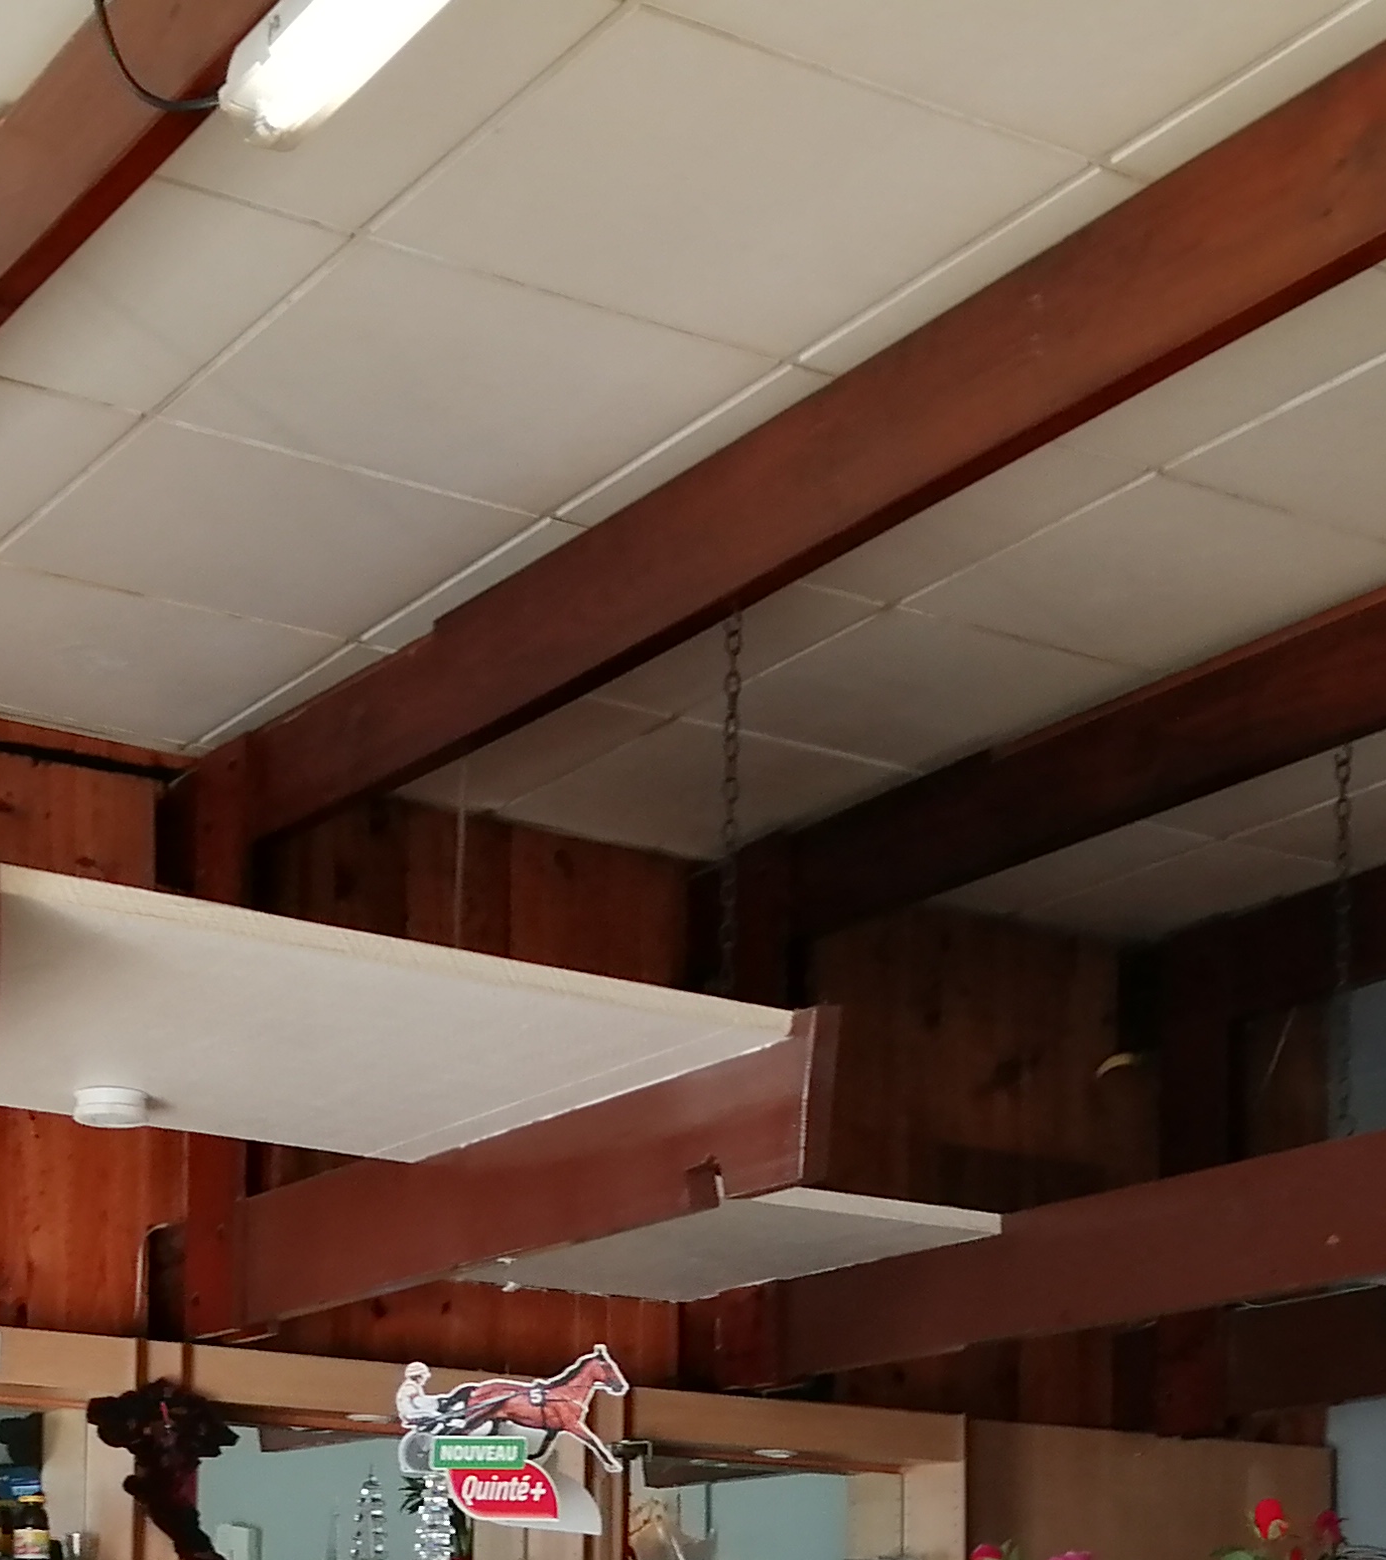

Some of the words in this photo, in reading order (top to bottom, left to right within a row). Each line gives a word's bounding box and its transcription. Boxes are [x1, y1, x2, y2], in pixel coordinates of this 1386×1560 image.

[528, 1388, 544, 1405] 5
[439, 1444, 519, 1462] NOUVEAU
[462, 1474, 547, 1506] Quinté+
